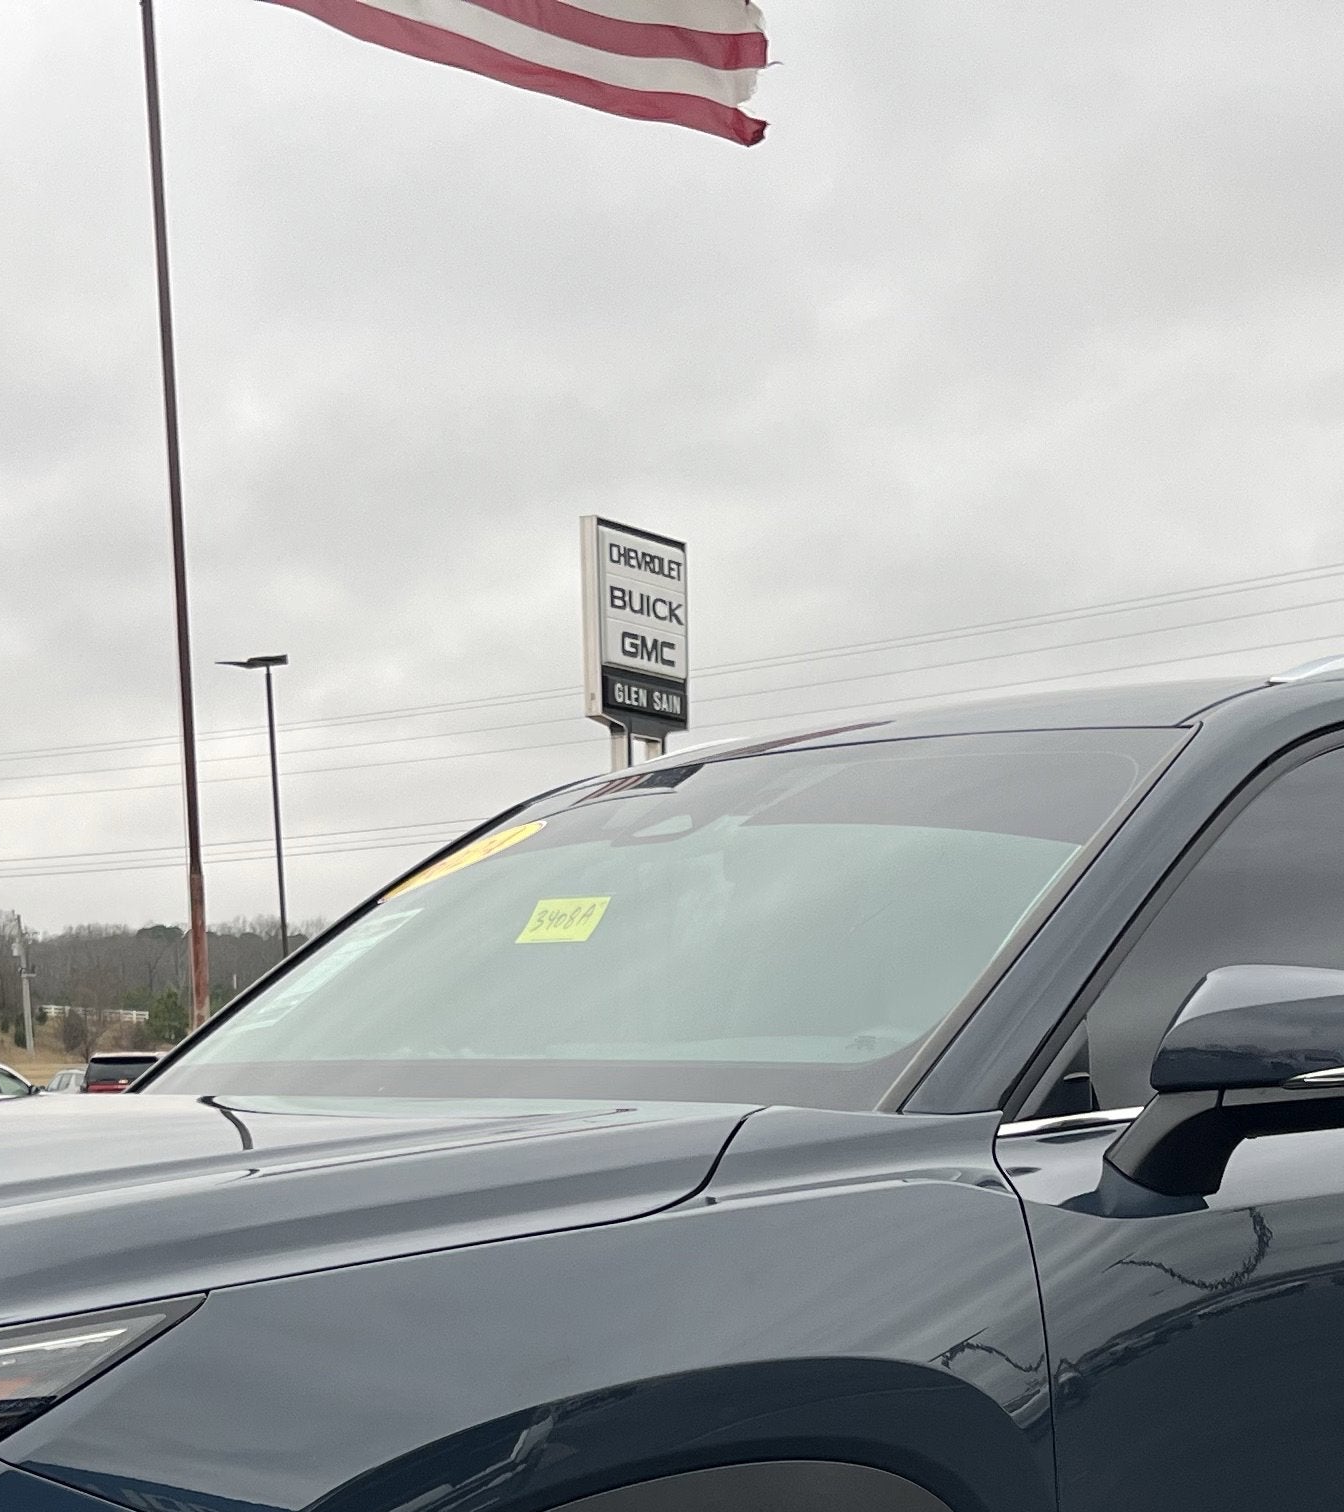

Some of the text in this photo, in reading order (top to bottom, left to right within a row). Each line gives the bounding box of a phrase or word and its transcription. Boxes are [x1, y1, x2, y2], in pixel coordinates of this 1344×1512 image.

[609, 542, 682, 582] CHEVROLET
[609, 585, 684, 626] BUICK
[621, 631, 676, 667] GMC
[614, 682, 681, 715] GLEN SAIN
